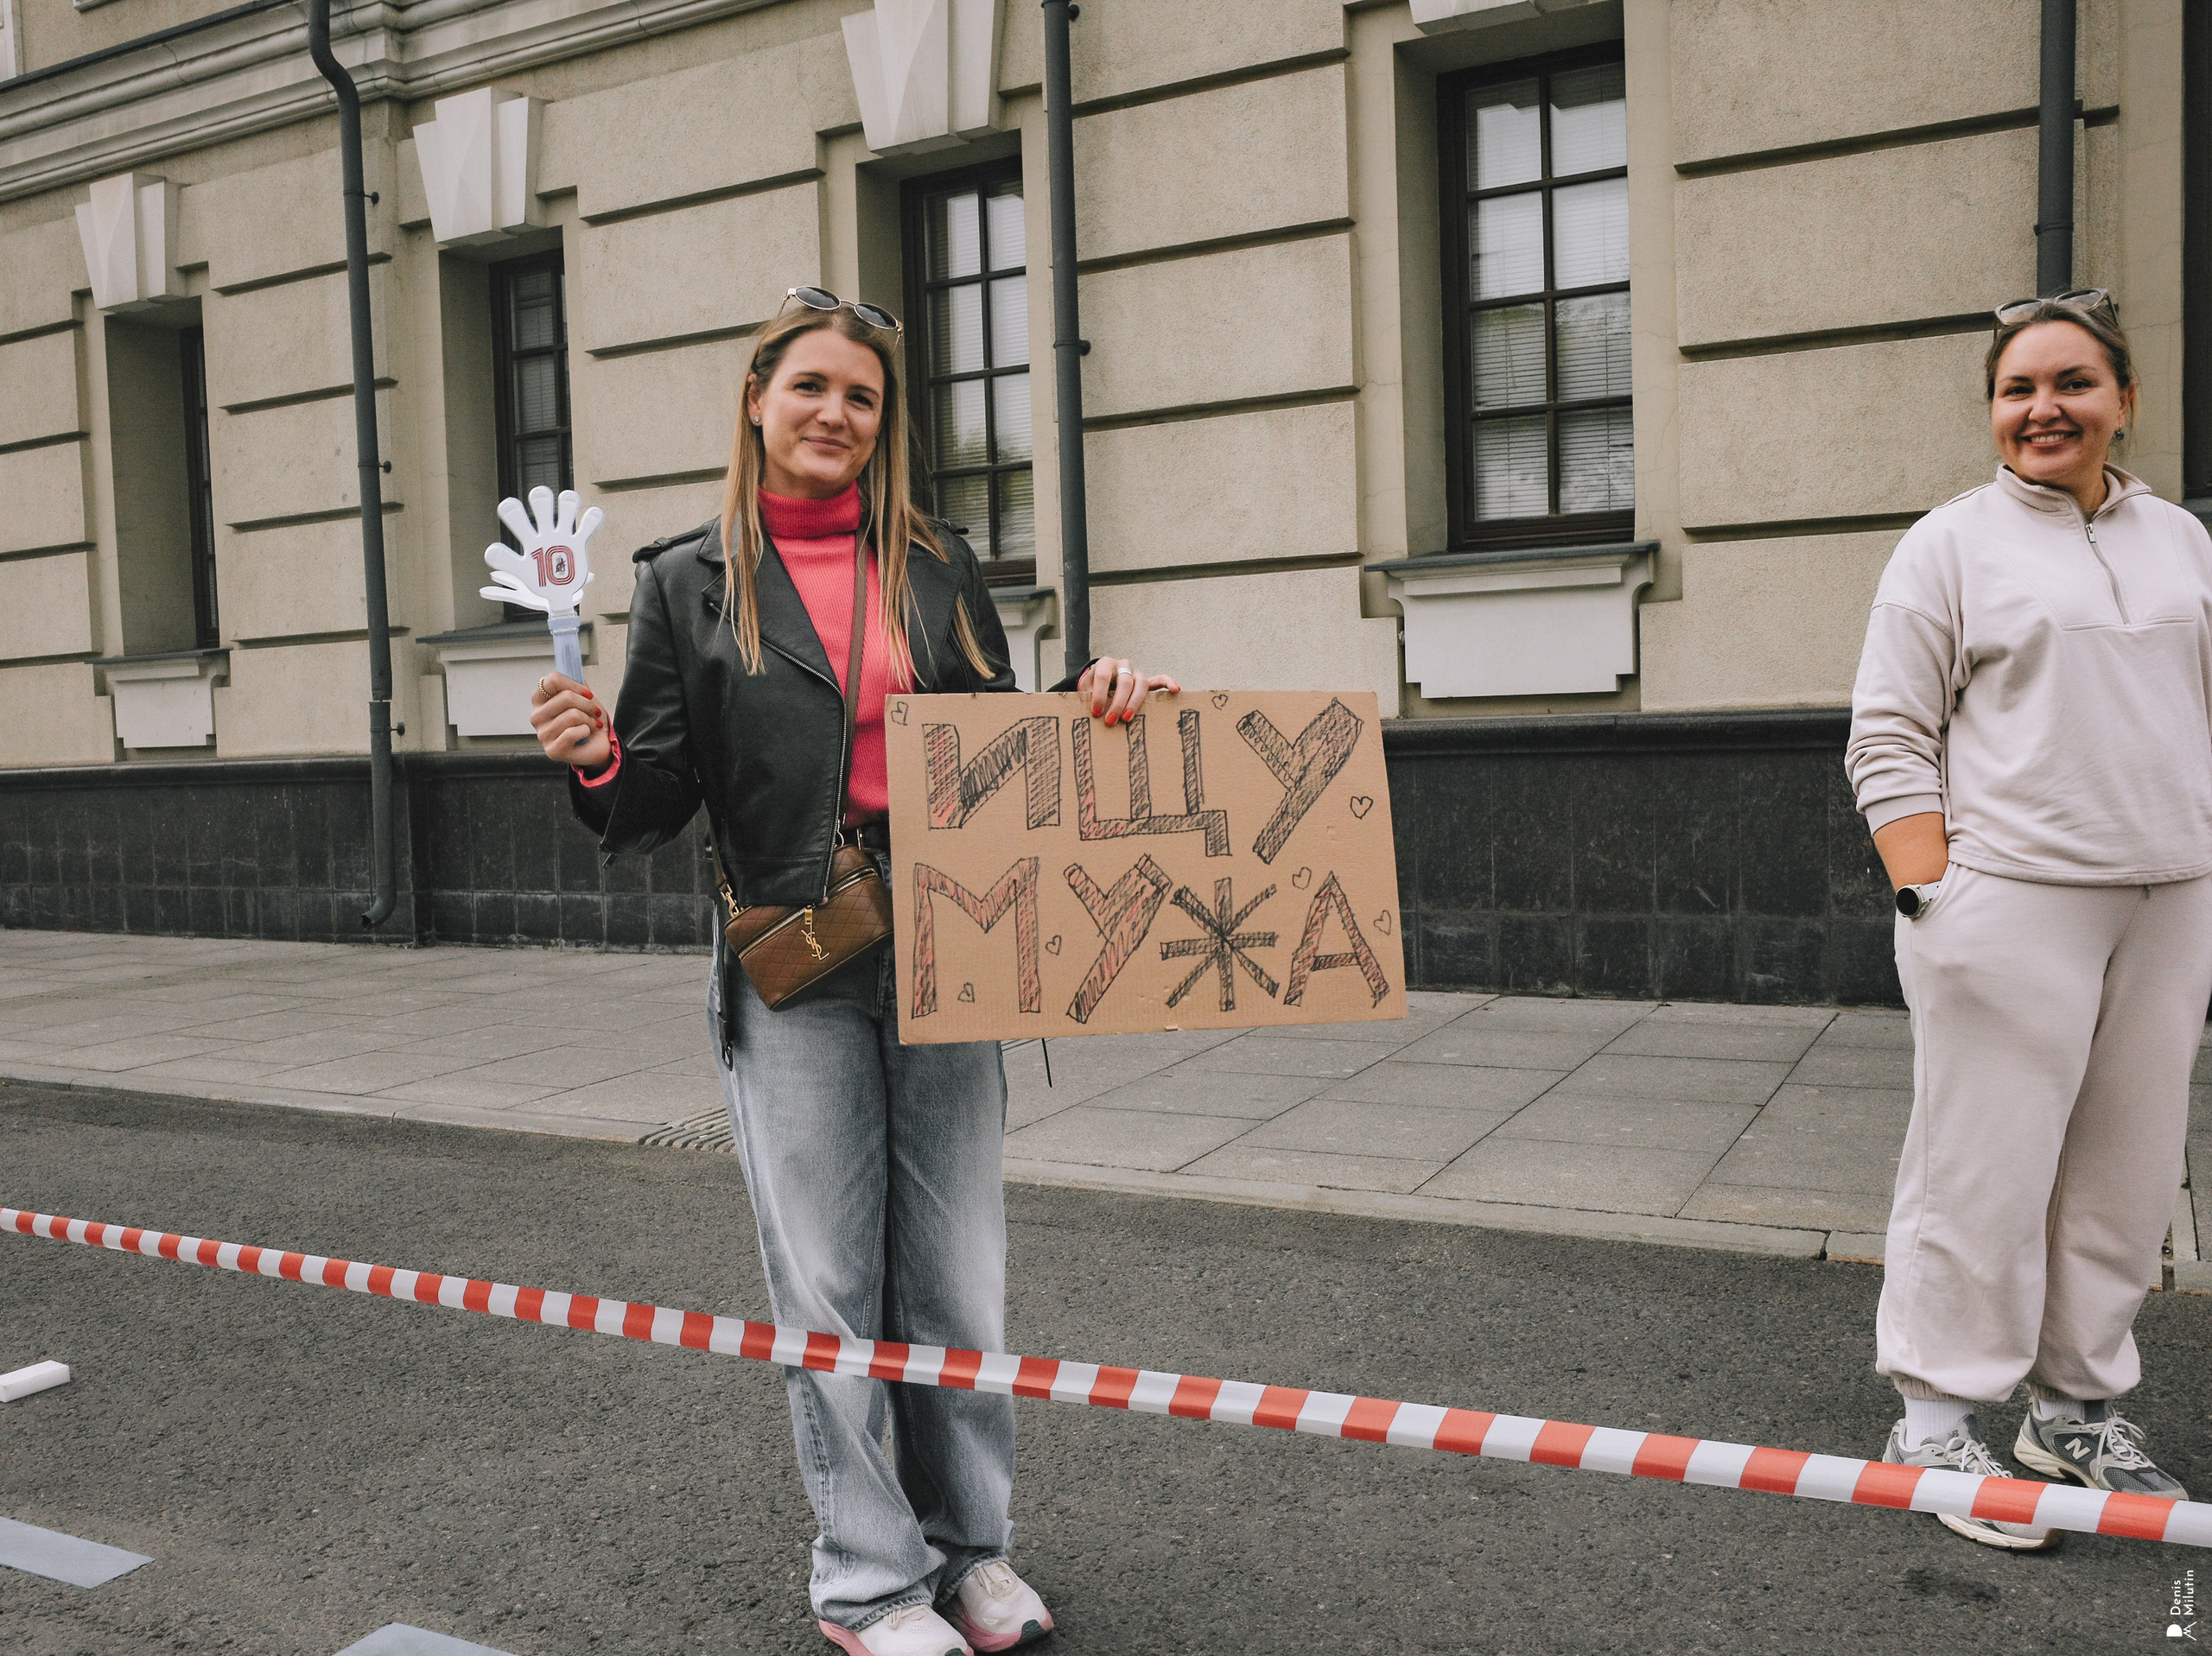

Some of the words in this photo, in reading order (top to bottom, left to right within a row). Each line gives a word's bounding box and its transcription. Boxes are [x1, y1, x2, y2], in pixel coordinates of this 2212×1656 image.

[531, 545, 575, 587] 10
[922, 697, 1364, 865] ИЩУ
[2064, 1437, 2091, 1460] N
